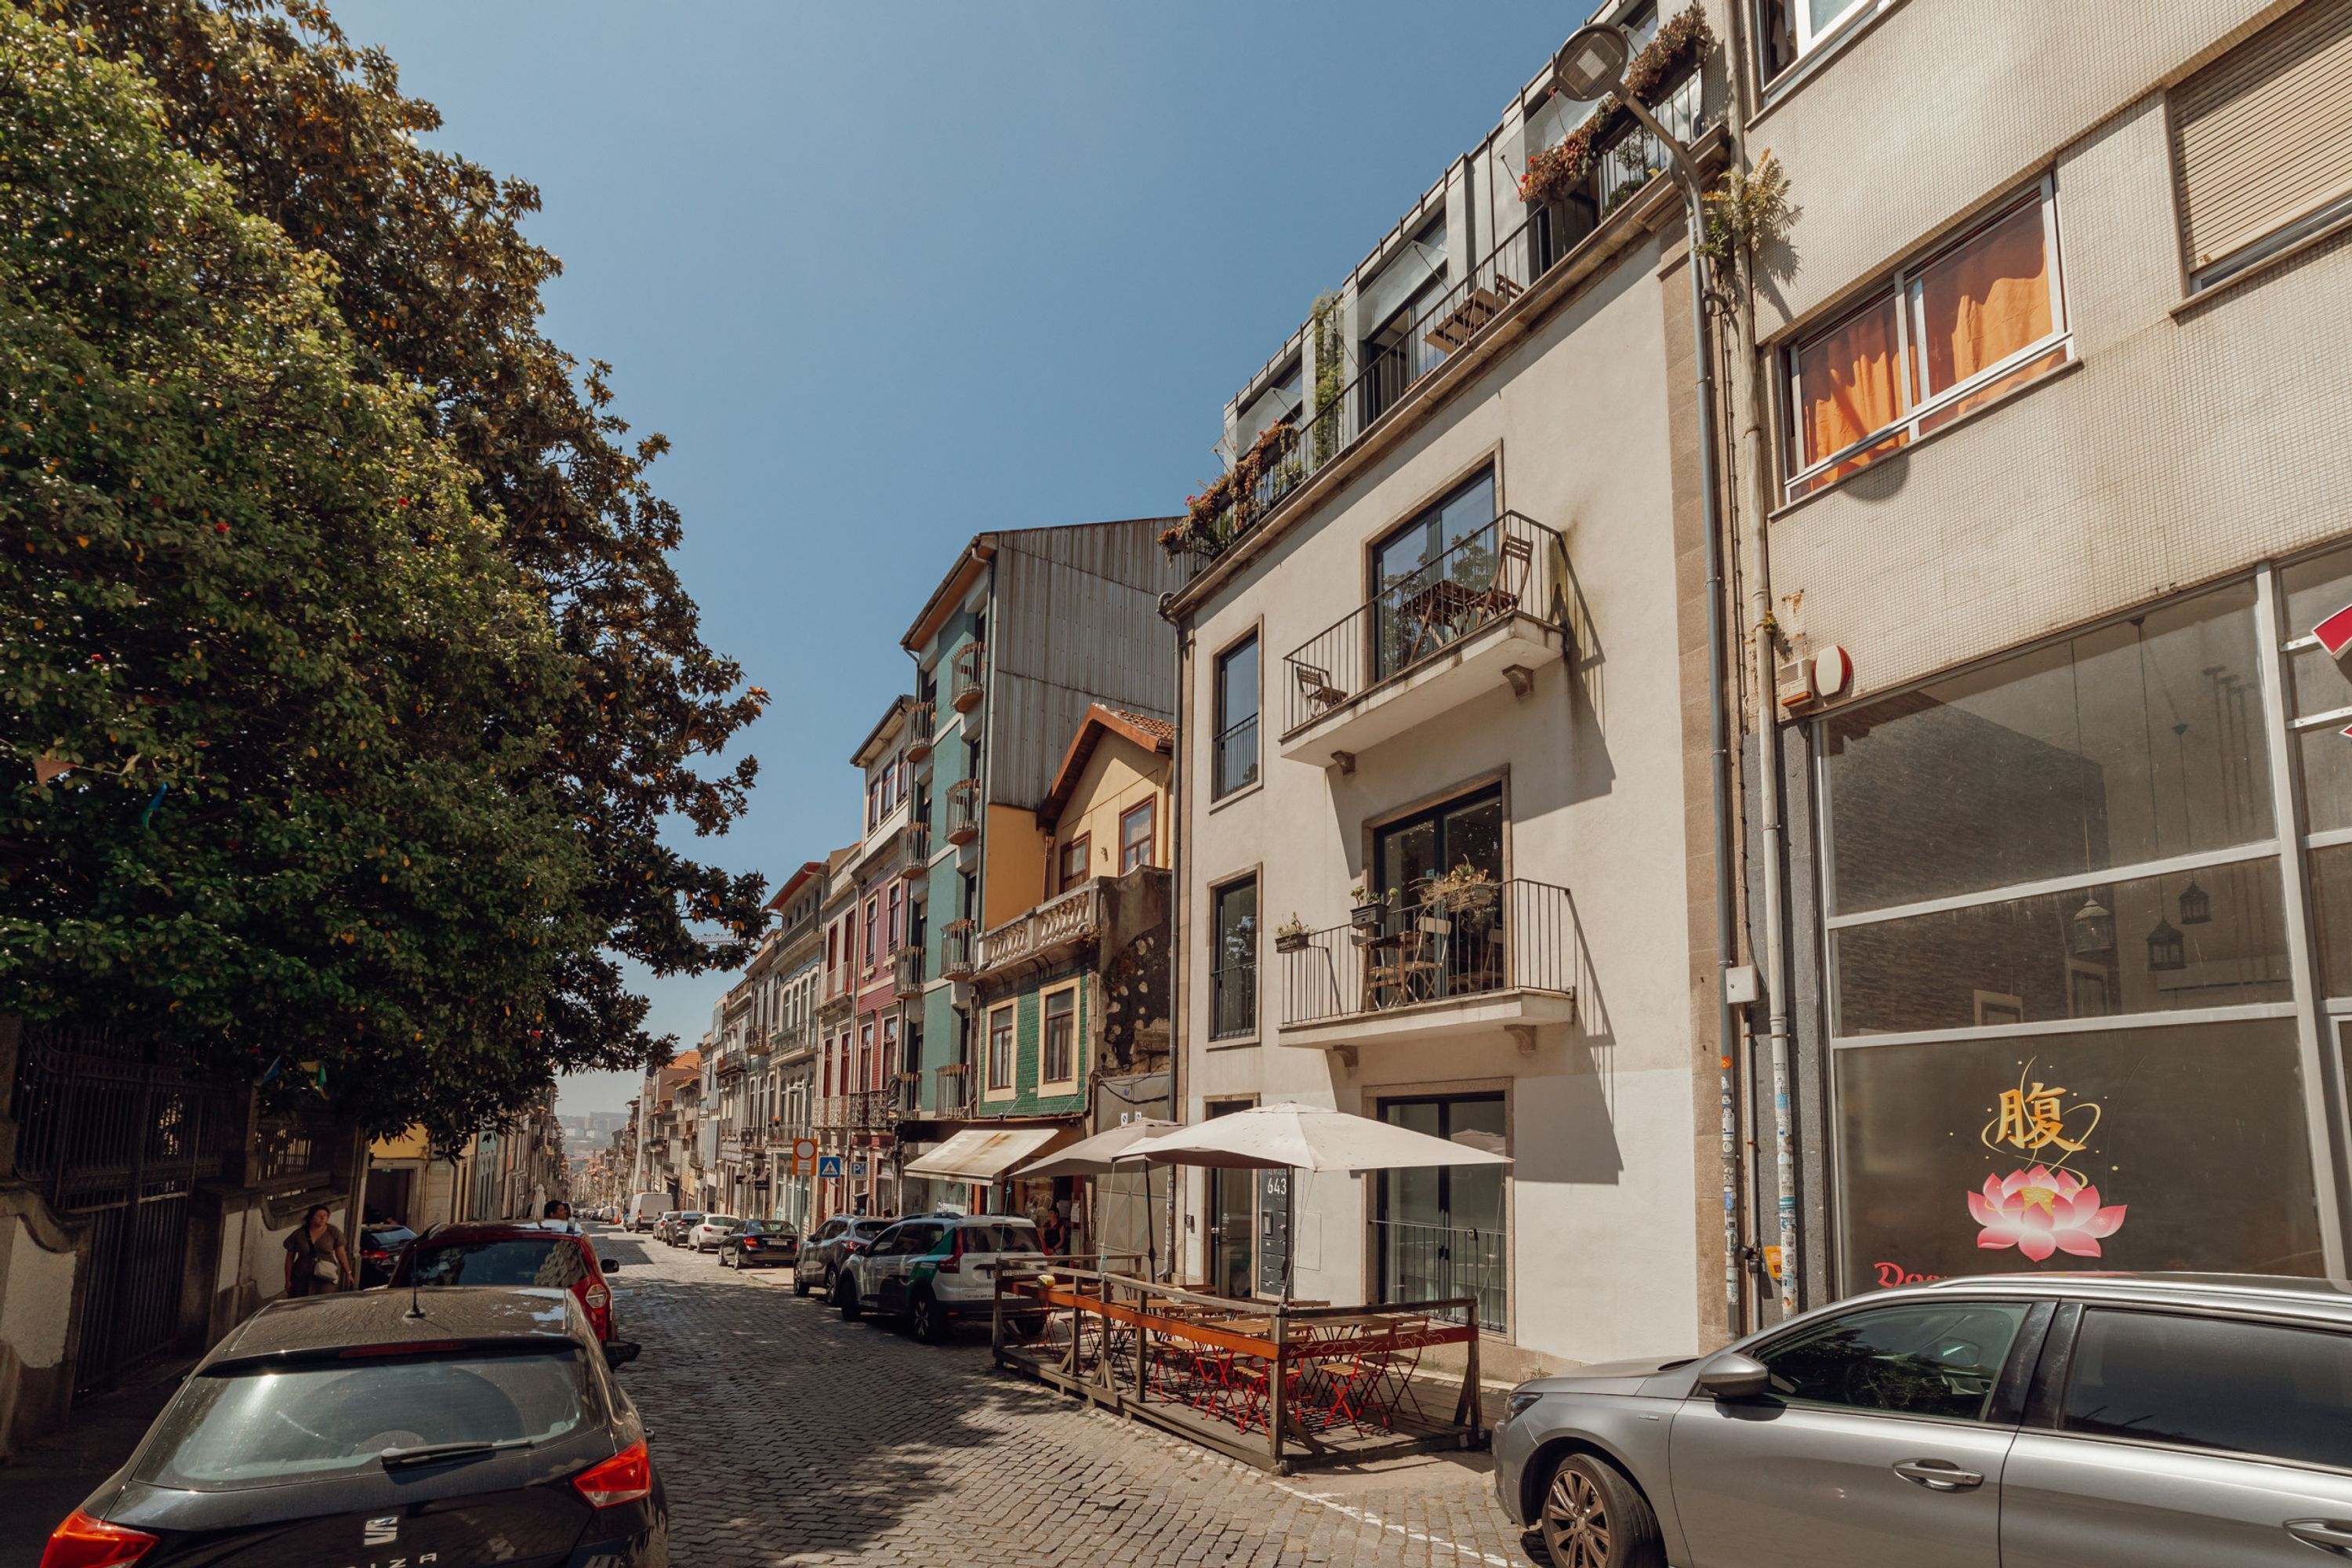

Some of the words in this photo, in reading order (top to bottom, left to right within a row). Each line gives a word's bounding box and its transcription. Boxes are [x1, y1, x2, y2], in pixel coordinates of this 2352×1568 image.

[1996, 1083, 2088, 1152] 腹
[852, 1163, 861, 1174] P
[1268, 1178, 1287, 1195] 643
